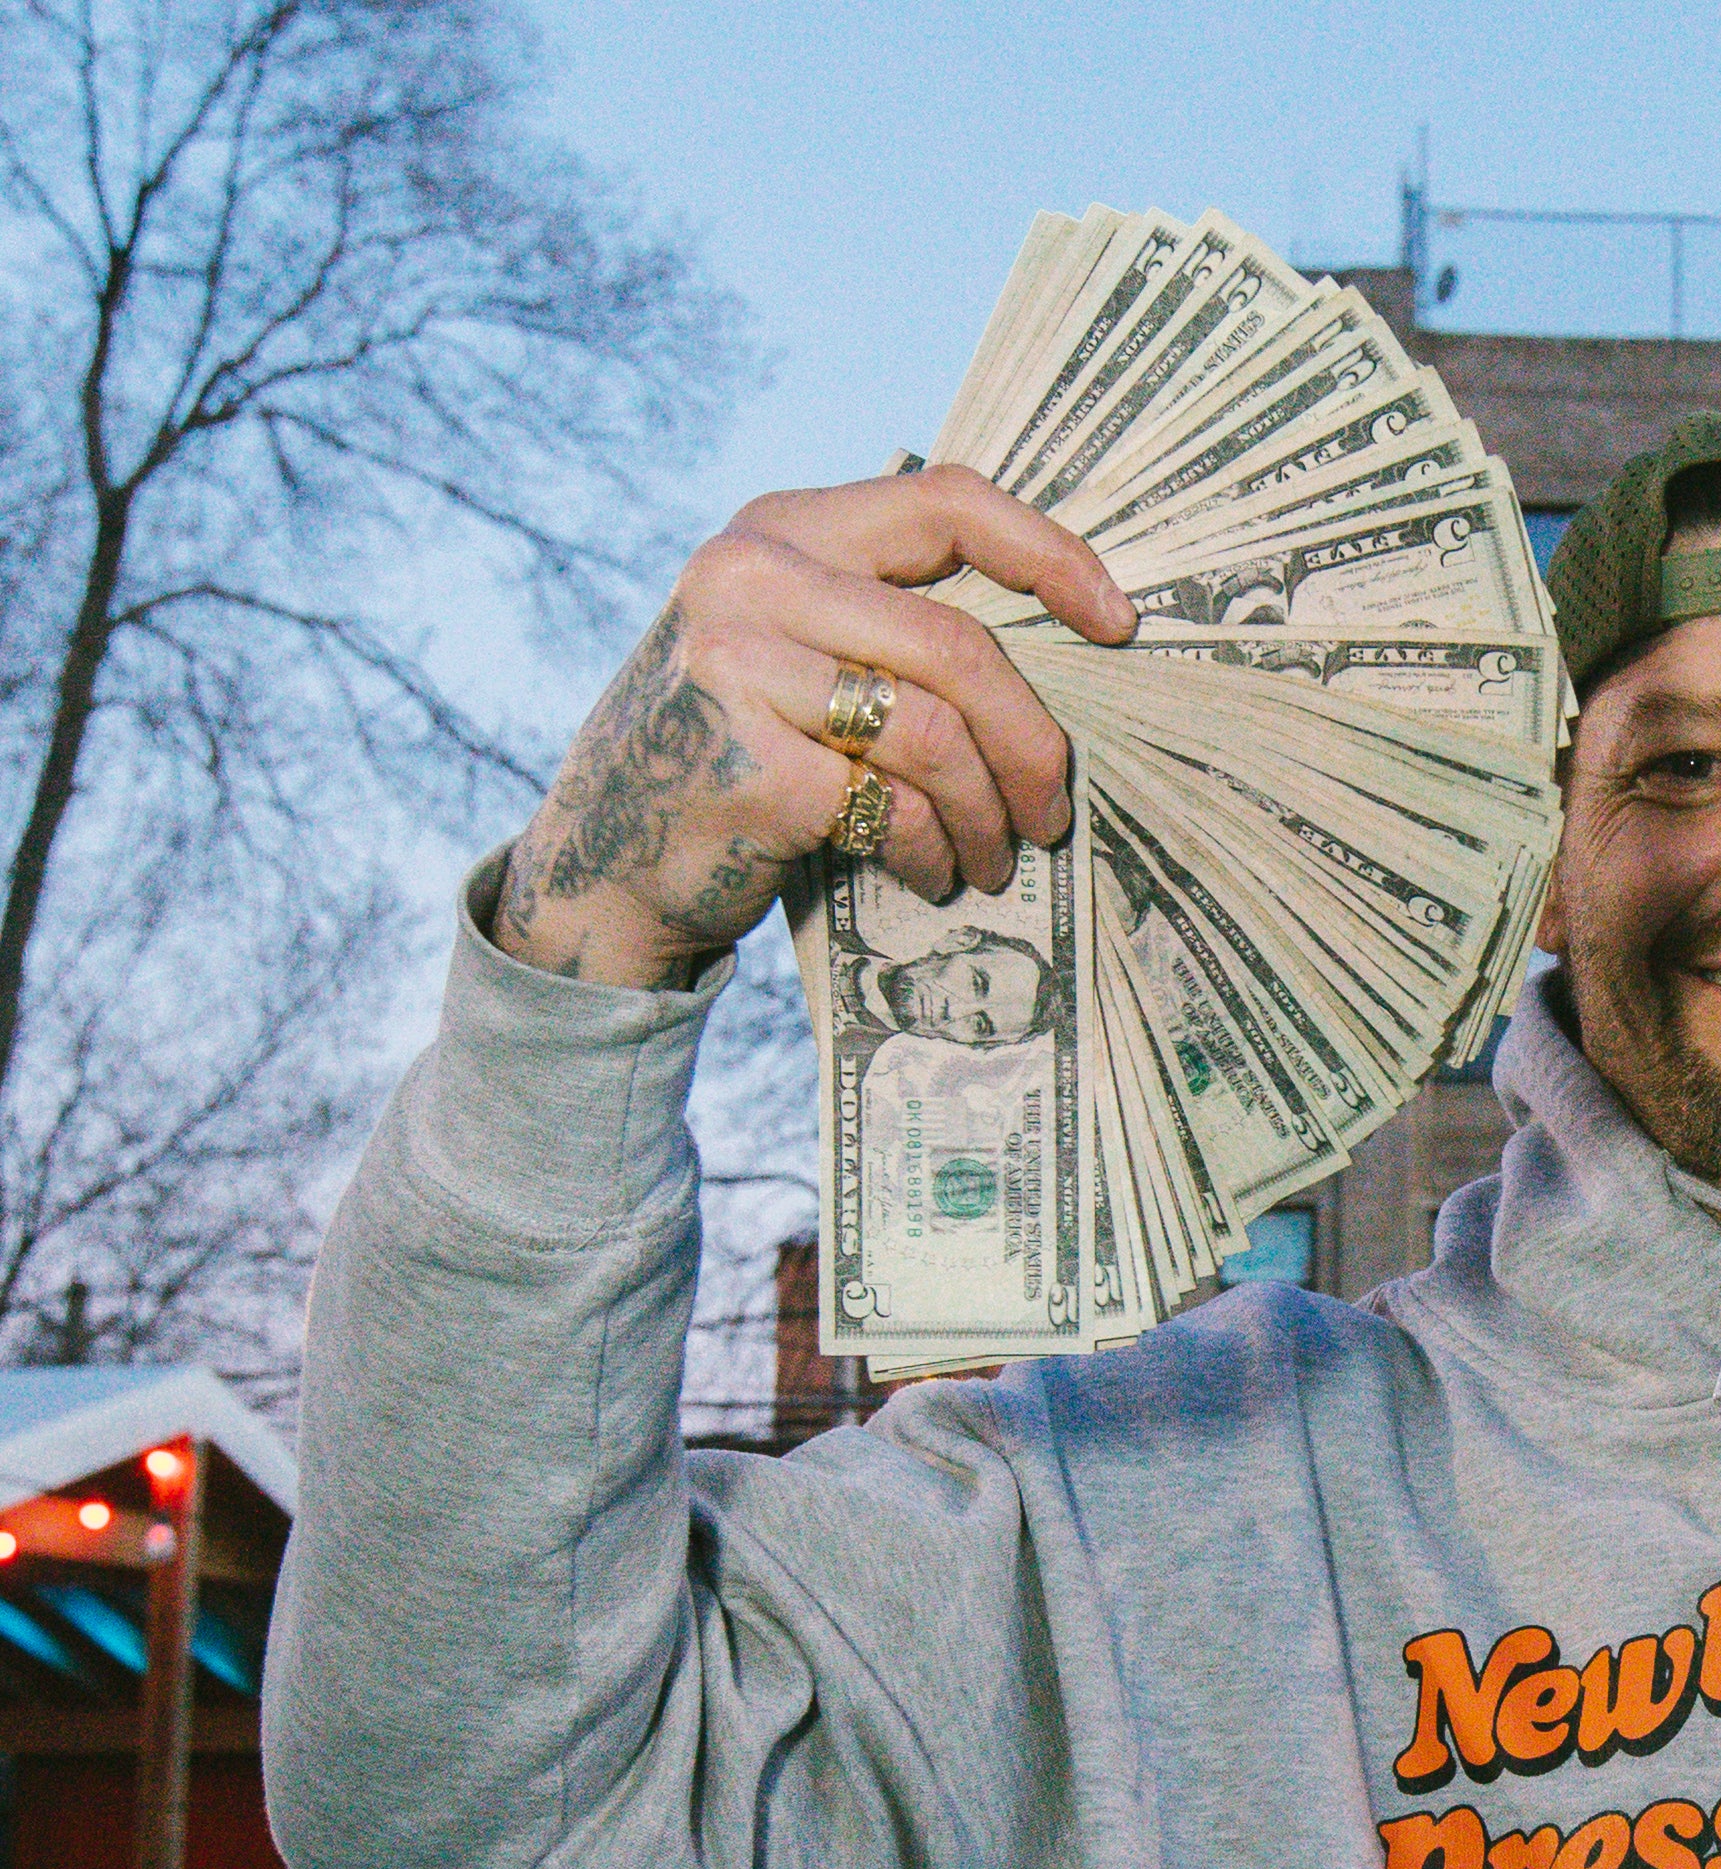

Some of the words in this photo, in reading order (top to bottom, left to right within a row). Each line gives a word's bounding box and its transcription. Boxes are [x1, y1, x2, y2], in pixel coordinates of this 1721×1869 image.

[1224, 264, 1263, 312] 5
[1144, 340, 1187, 387] NOTE
[1301, 529, 1403, 569] FIVE
[1427, 512, 1477, 569] 5
[1347, 647, 1447, 663] FIVE
[1477, 651, 1517, 696] 5
[1295, 822, 1390, 886] FIVE
[1024, 1089, 1041, 1133] THE
[1062, 1056, 1072, 1149] RESERVE
[839, 1056, 857, 1256] DOLLARS
[1005, 1133, 1021, 1160] OF
[1024, 1140, 1041, 1218] UNITED
[1063, 1176, 1073, 1227] NOTE
[1004, 1163, 1021, 1262] AMERICA
[1024, 1222, 1041, 1301] STATES
[842, 1283, 892, 1321] 5
[1048, 1283, 1079, 1328] 5
